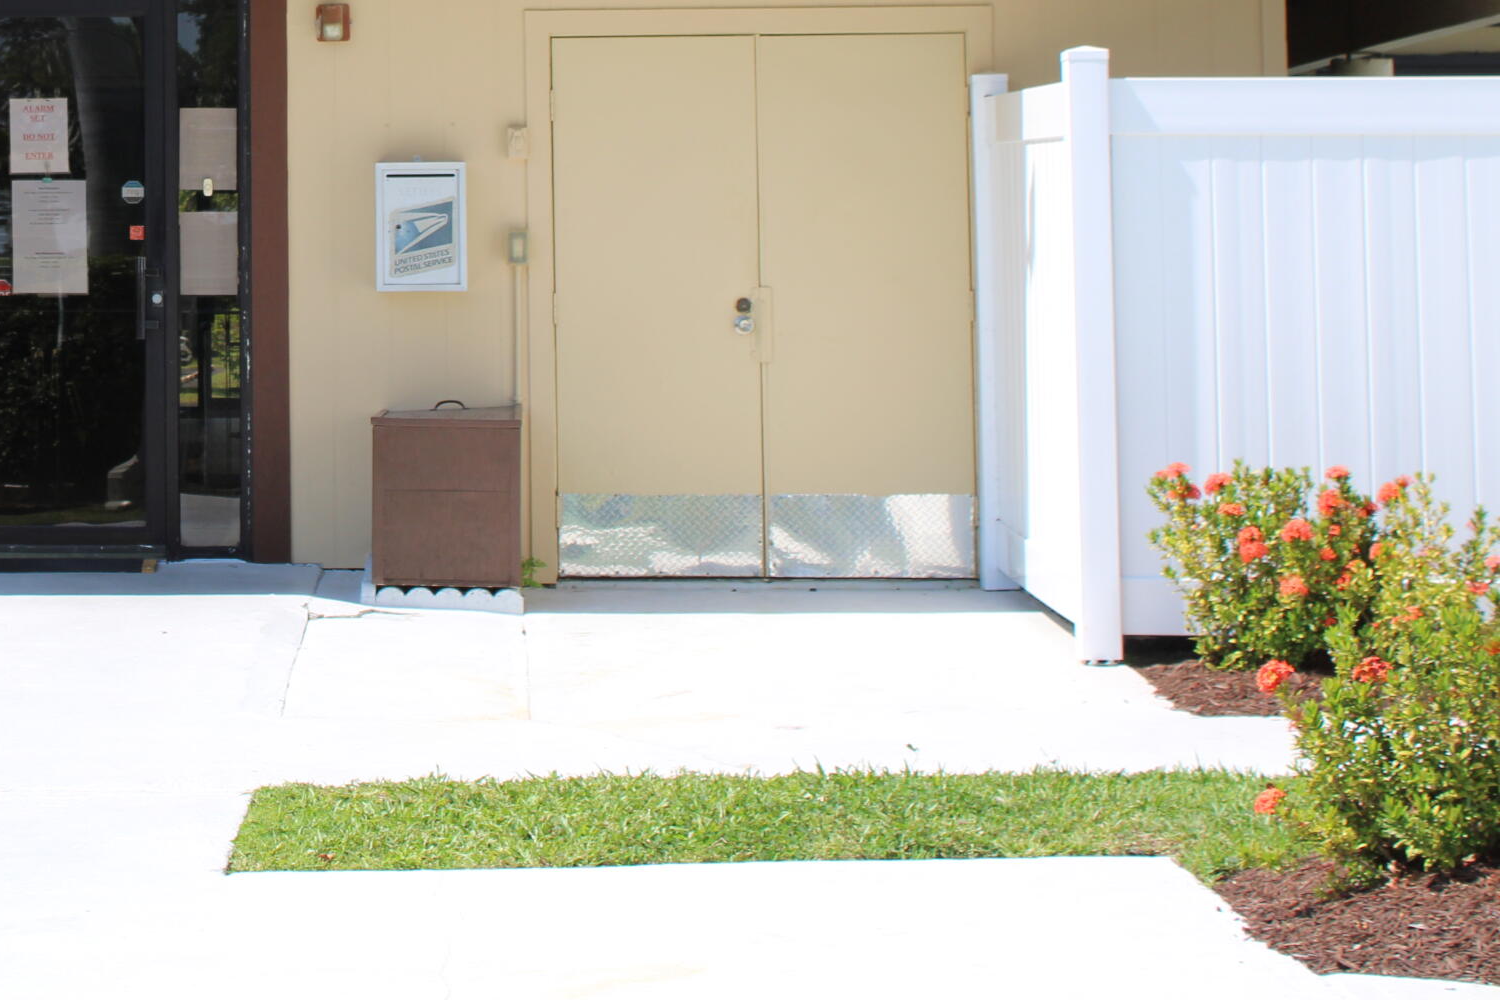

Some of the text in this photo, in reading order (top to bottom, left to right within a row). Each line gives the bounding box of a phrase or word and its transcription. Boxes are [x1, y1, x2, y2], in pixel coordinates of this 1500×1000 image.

[23, 105, 54, 113] ALARM
[23, 133, 55, 141] DO NOT
[25, 152, 53, 160] ENTER
[394, 248, 450, 267] UNITED STATES
[394, 256, 453, 274] POSTAL SERVICE
